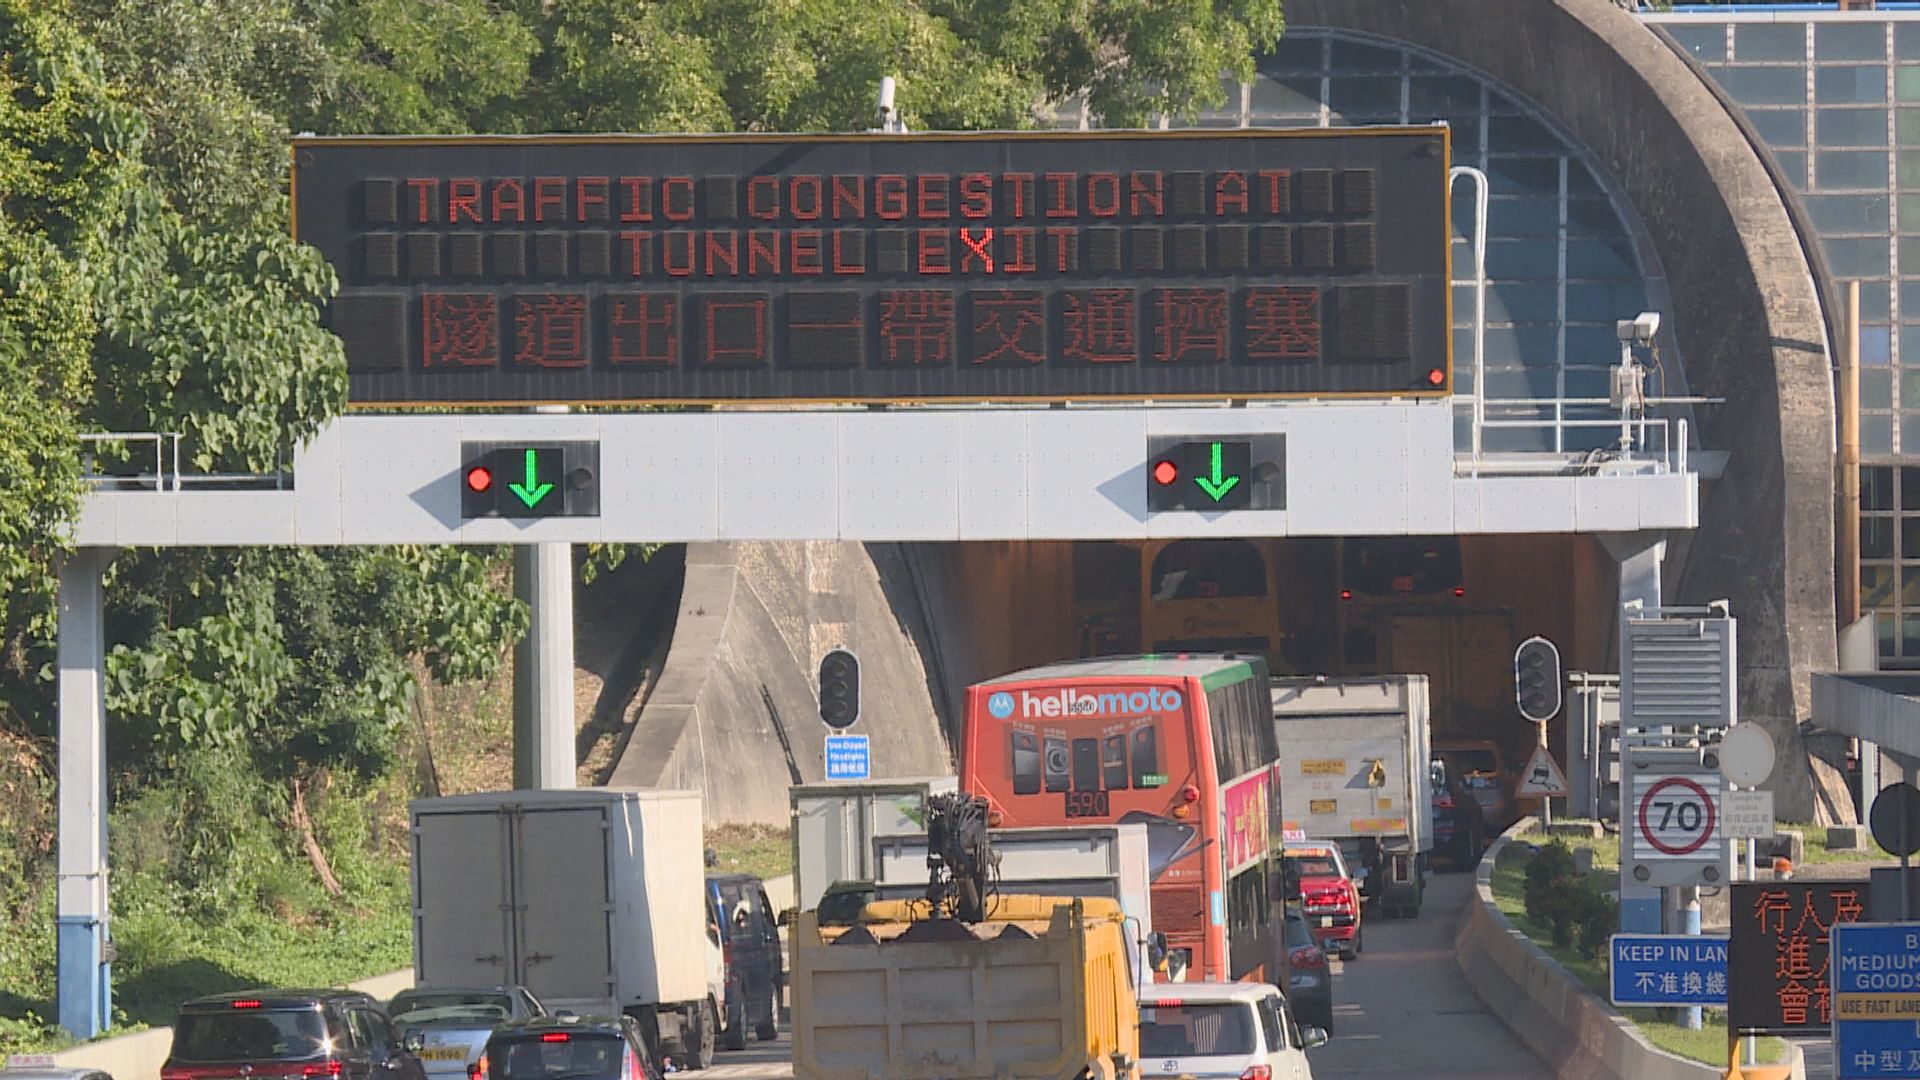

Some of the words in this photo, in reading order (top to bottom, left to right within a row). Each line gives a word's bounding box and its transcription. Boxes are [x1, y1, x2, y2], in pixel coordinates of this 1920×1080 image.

[407, 177, 694, 224] TRAFFIC
[747, 171, 1163, 221] CONGESTION
[1216, 168, 1291, 216] AT
[620, 230, 866, 276] TUNNEL
[917, 226, 1079, 274] EXIT
[422, 286, 1323, 368] 隧道出口一帶交通擠塞
[1067, 790, 1108, 817] 590
[1654, 802, 1702, 831] 70
[1754, 889, 1863, 935] 行人及
[1619, 945, 1664, 962] KEEP
[1670, 945, 1689, 961] IN
[1695, 945, 1728, 963] LAN
[1842, 954, 1920, 971] MEDIUM
[1842, 1000, 1861, 1013] USE
[1866, 1000, 1890, 1013] FAST
